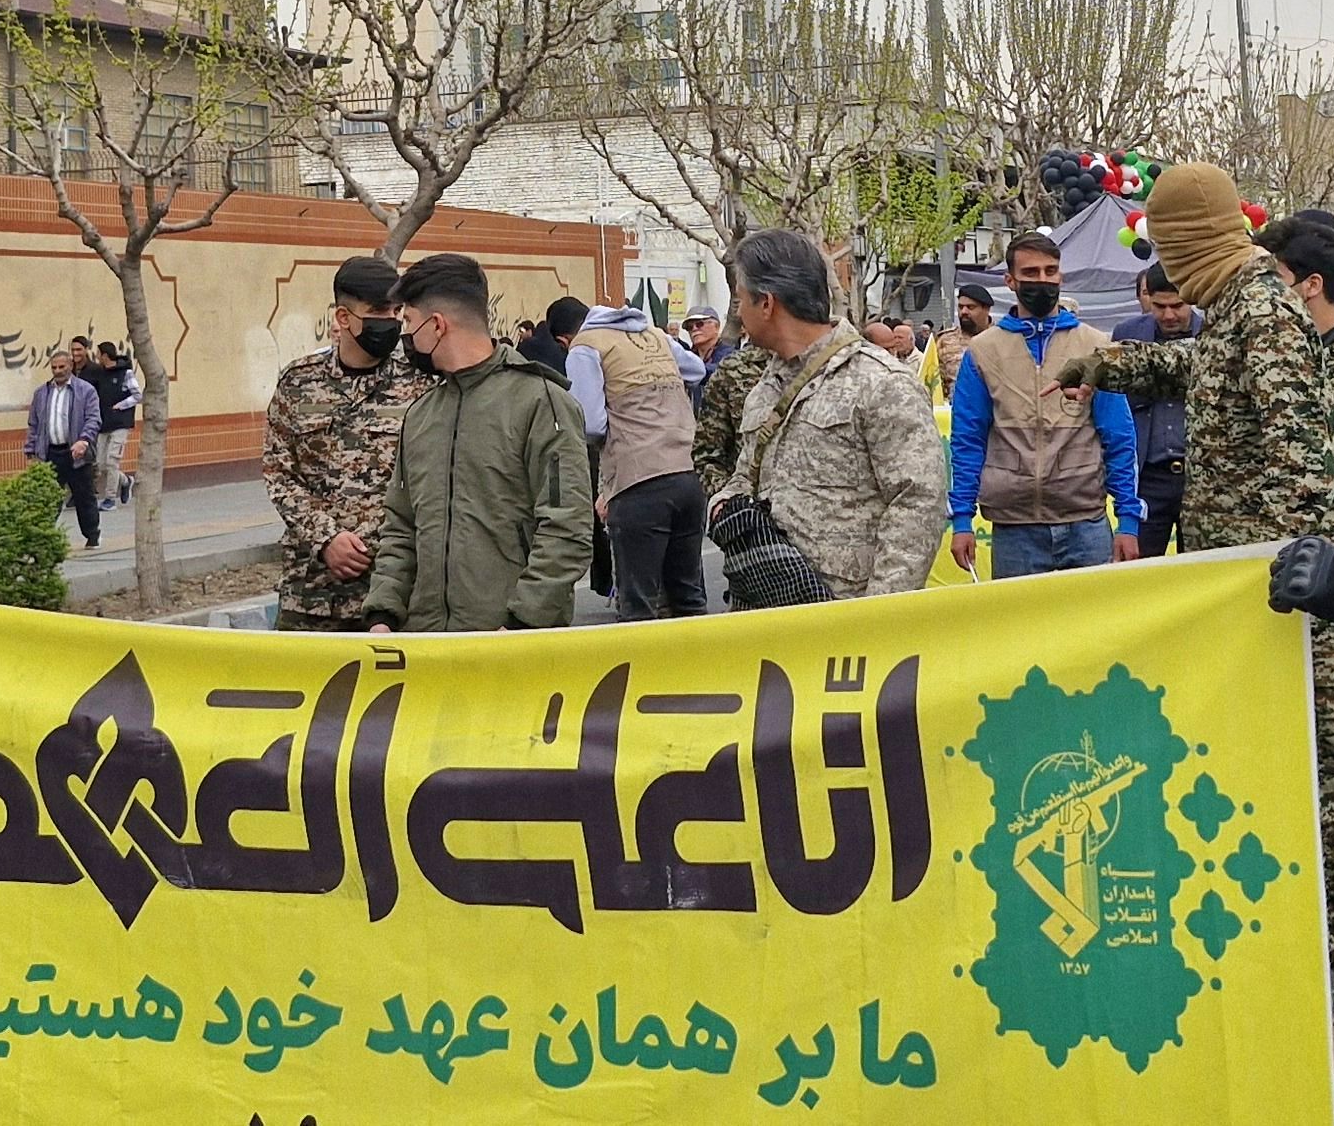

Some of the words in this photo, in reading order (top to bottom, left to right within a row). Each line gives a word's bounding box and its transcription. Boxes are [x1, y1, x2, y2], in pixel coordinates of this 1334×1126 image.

[1104, 907, 1157, 925] انقلاب
[202, 968, 344, 1073] خود
[366, 992, 510, 1086] عهد
[533, 984, 738, 1090] همان
[757, 1022, 836, 1111] بر
[858, 998, 938, 1089] ما
